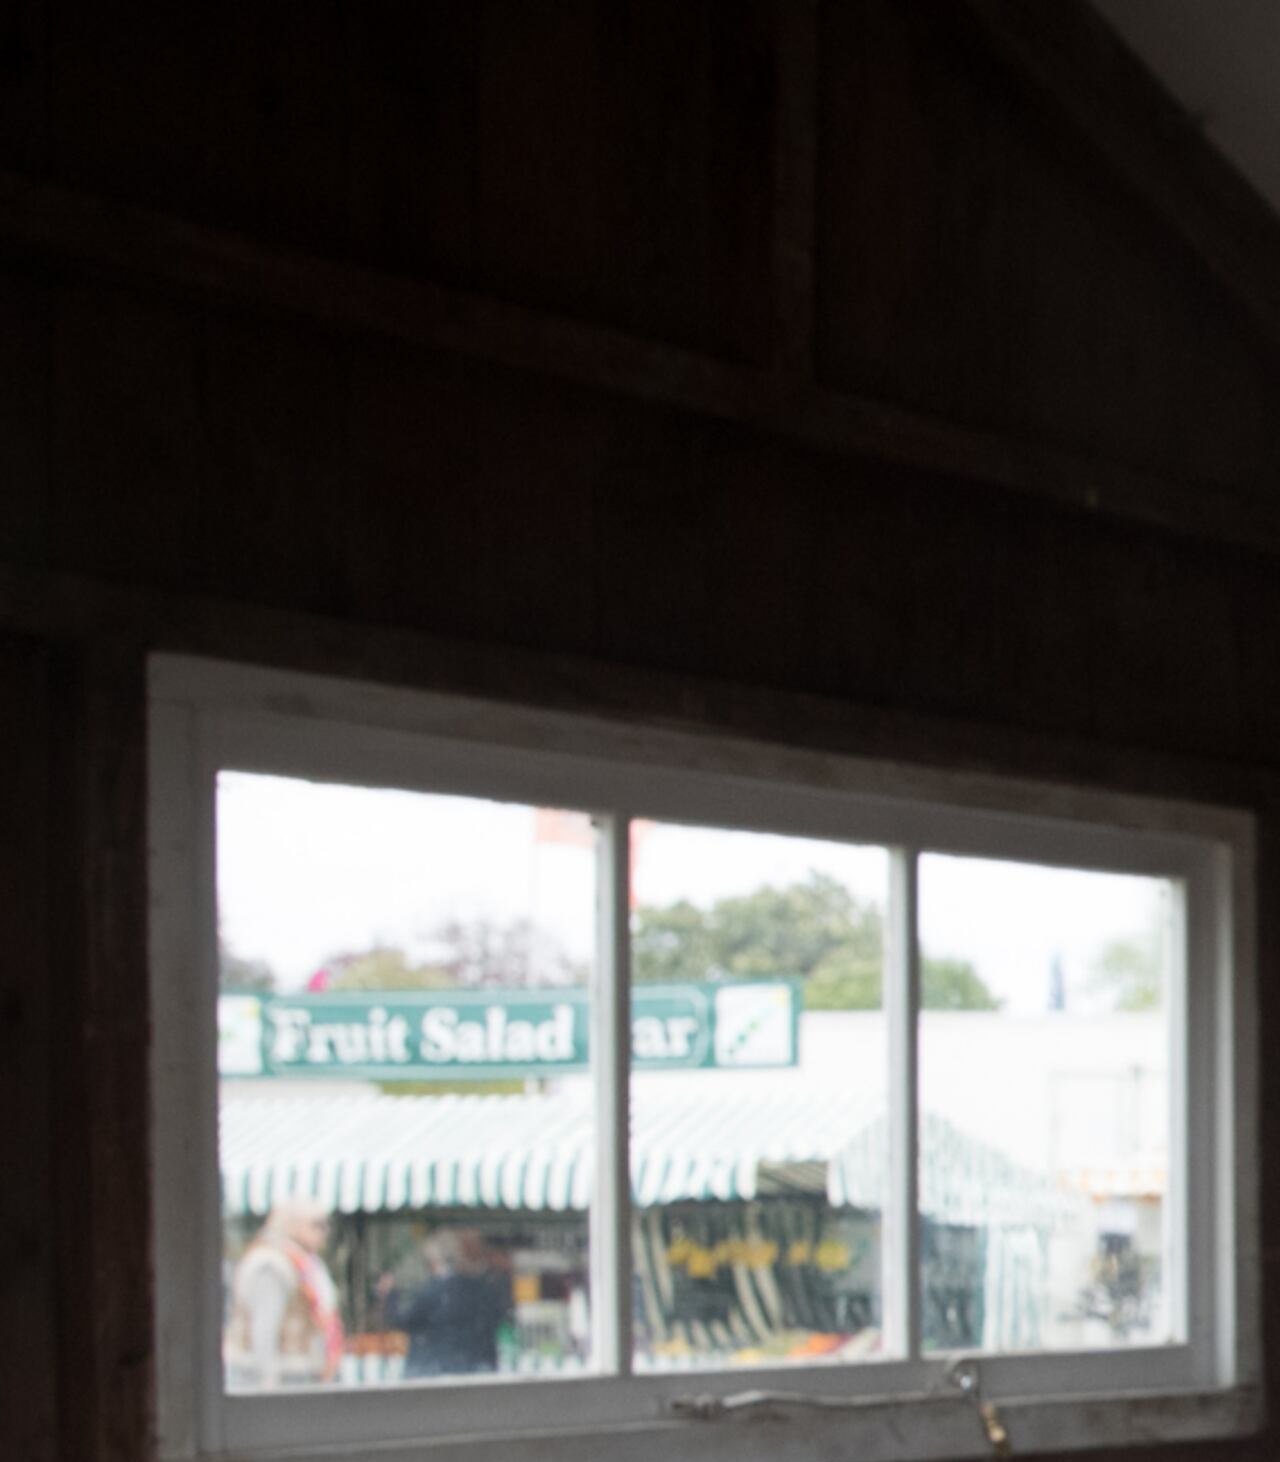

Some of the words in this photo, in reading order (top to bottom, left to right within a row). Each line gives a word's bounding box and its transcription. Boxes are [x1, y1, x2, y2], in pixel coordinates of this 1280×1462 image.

[269, 1007, 409, 1062] Fruit
[421, 1005, 576, 1061] Salad
[632, 1014, 696, 1059] ar
